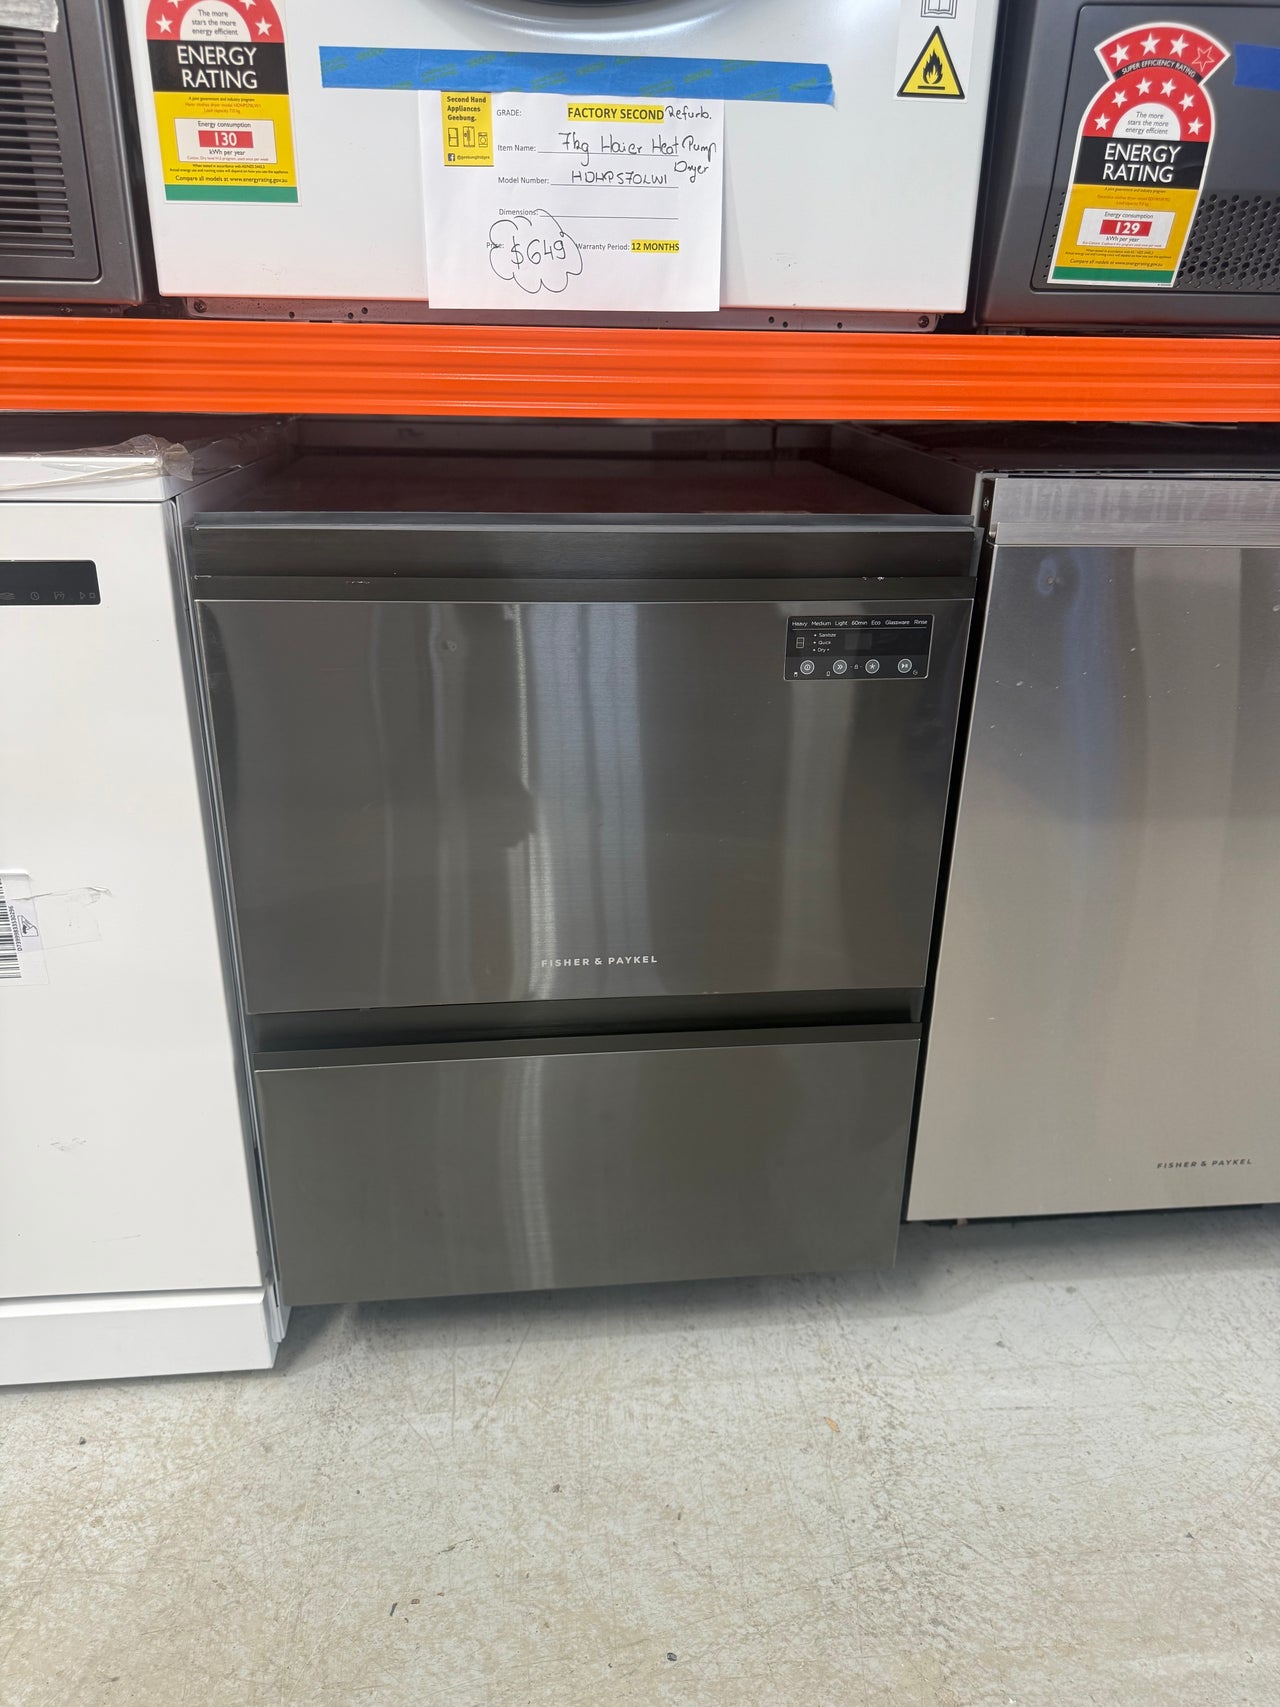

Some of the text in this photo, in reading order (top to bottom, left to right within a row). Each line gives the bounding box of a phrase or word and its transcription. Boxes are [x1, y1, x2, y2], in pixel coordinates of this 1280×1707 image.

[198, 9, 210, 17] The
[208, 18, 218, 26] the
[177, 45, 257, 66] ENERGY
[1121, 59, 1197, 78] SUPER EFFICIENCY RATING
[182, 69, 258, 89] RATING
[447, 105, 481, 113] Appliances
[496, 109, 522, 117] GRADE:
[568, 107, 617, 119] FACTORY
[620, 108, 664, 120] SECOND
[448, 114, 477, 122] Geebung.
[198, 121, 216, 129] Energy
[1125, 127, 1168, 135] energy efficient
[214, 131, 238, 147] 130
[497, 132, 717, 167] Item Name: 7kg Haier Heat Pump
[1104, 143, 1181, 164] ENERGY
[176, 174, 198, 182] Compare
[1102, 164, 1174, 183] RATING
[498, 176, 520, 184] Model
[520, 176, 550, 185] Number:
[498, 208, 539, 216] Dimensions:
[1104, 211, 1154, 220] Energy consumption
[1115, 221, 1141, 236] 129
[576, 242, 680, 251] Warranty Period: 12 MONTHS
[510, 235, 566, 270] $649
[542, 955, 658, 968] FISHER & PAYKEL
[1156, 1161, 1198, 1169] FISHER
[1212, 1158, 1253, 1166] PAYKEL
